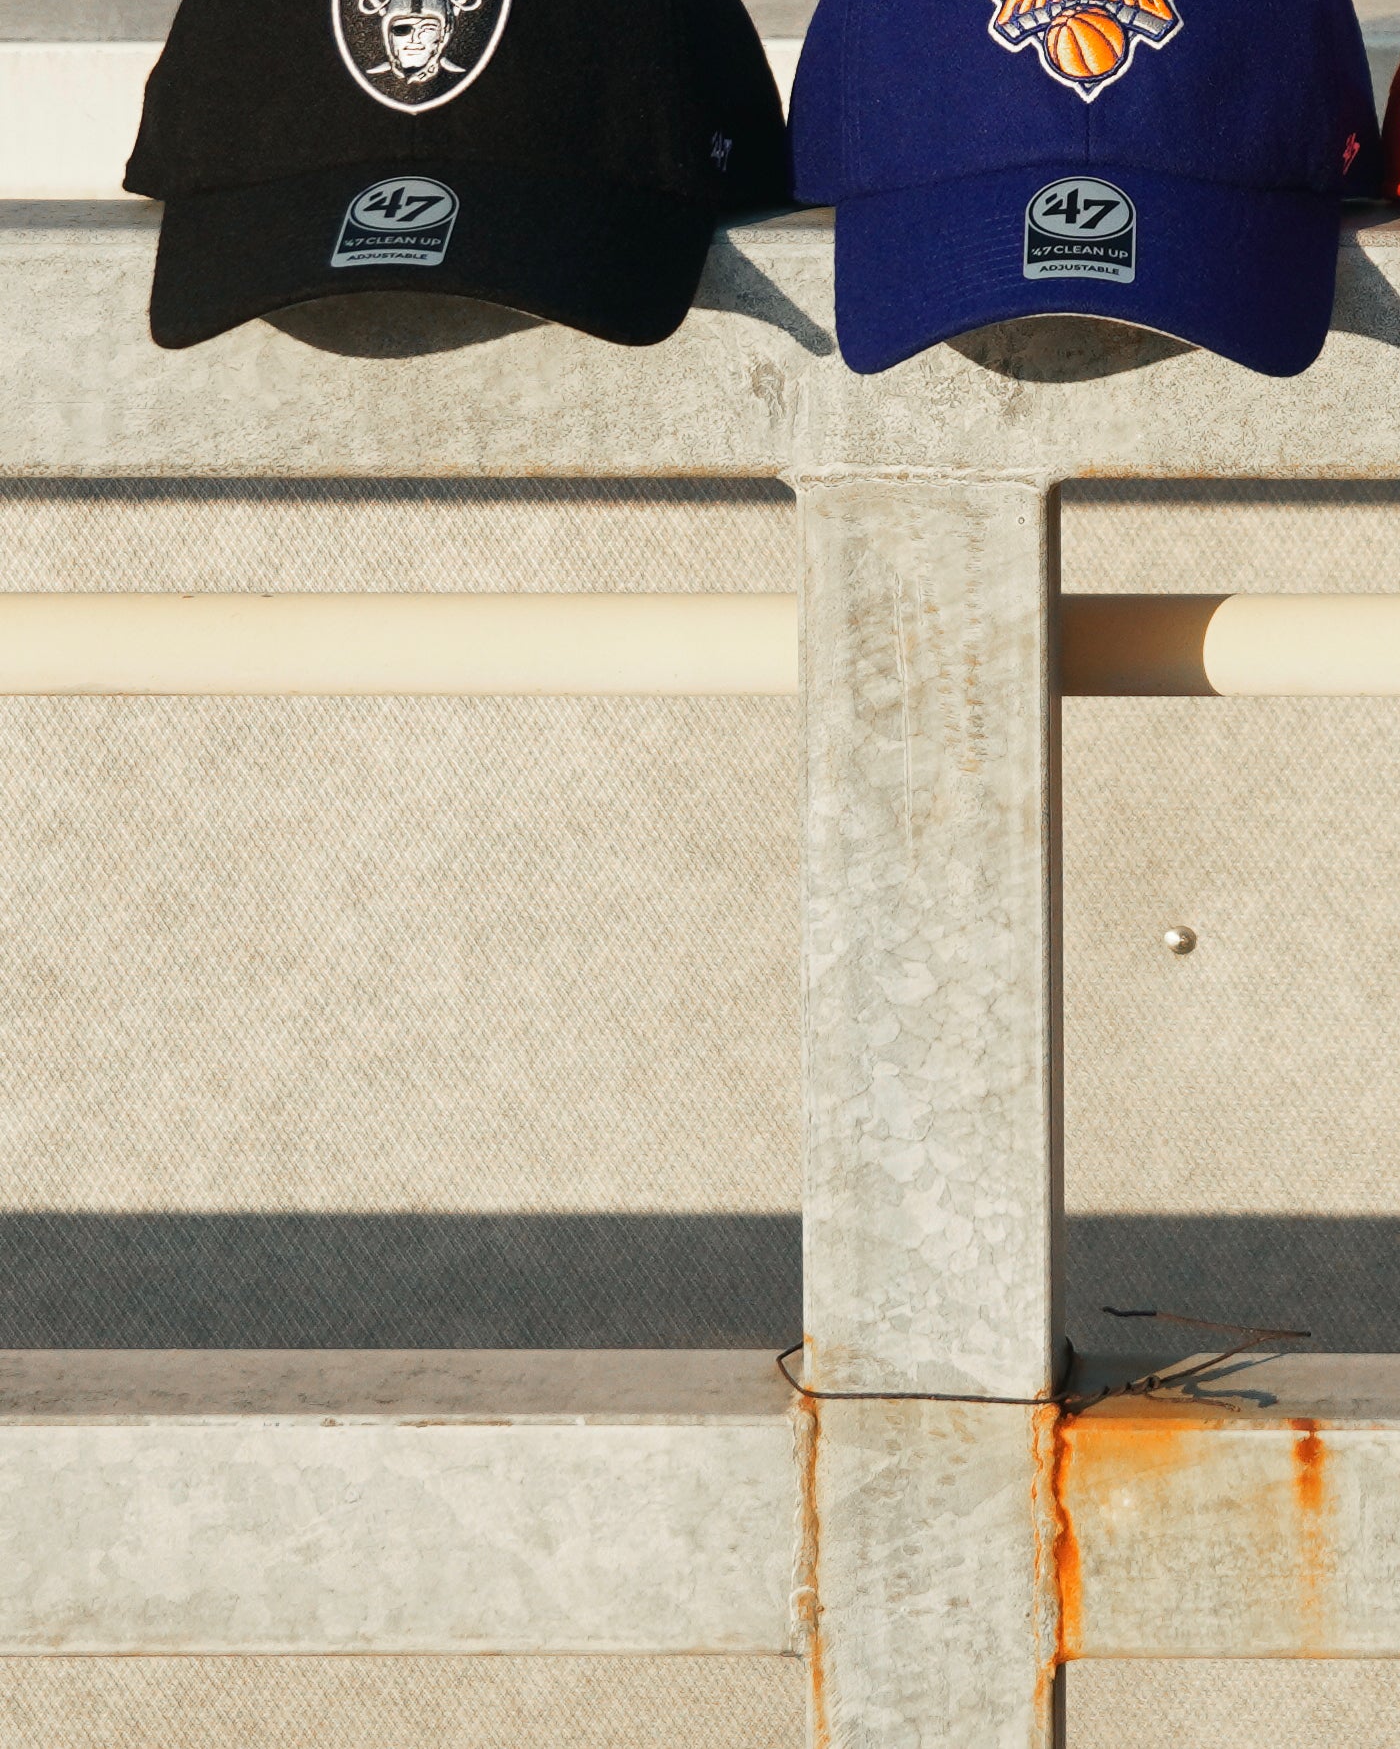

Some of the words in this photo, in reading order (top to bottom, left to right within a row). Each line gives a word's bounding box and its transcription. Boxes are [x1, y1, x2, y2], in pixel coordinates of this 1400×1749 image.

[365, 236, 417, 245] CLEAN
[420, 237, 442, 247] UP
[346, 253, 428, 261] ADJUSTABLE
[1053, 245, 1104, 256] CLEAN
[1108, 248, 1129, 259] UP
[1039, 264, 1120, 275] ADJUSTABLE
